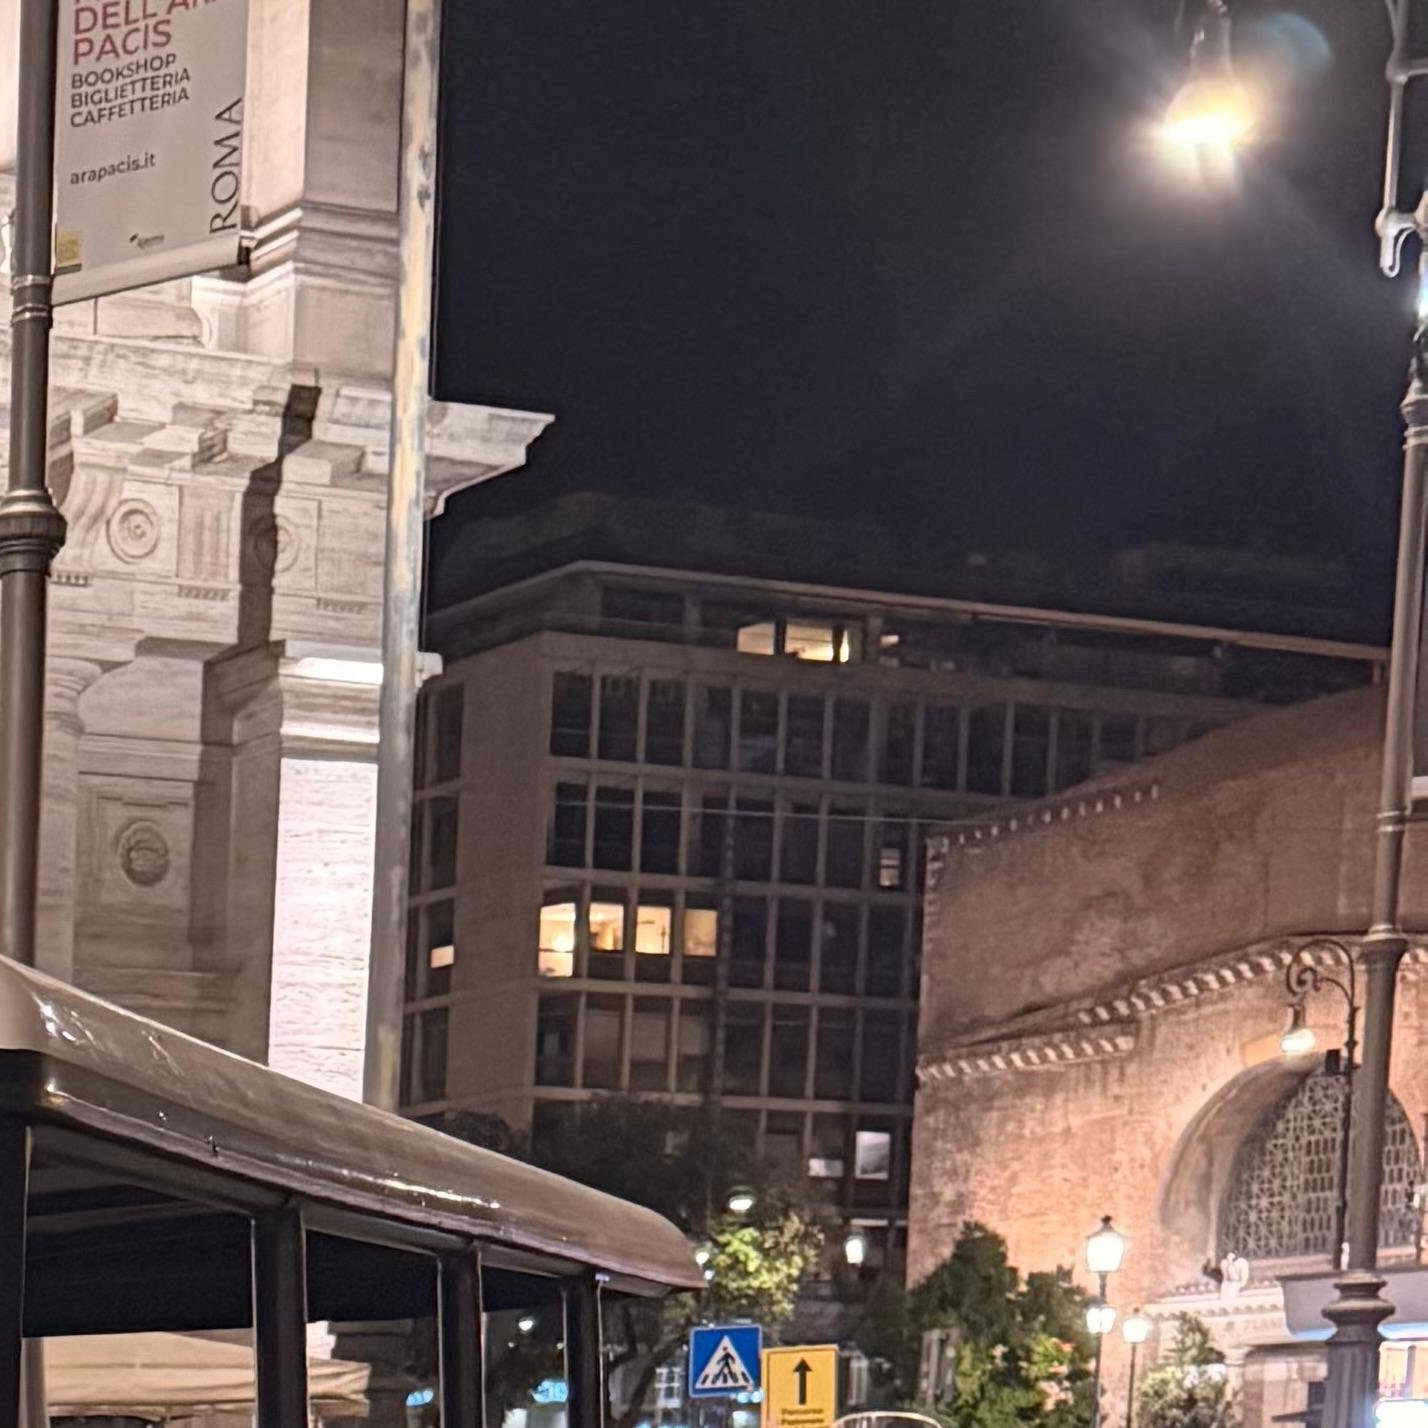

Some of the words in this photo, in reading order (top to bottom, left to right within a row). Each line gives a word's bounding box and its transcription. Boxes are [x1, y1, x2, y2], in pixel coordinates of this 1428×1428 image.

[73, 19, 172, 65] PACIS
[71, 53, 177, 89] BOOKSHOP
[71, 68, 191, 109] BIGLIETTERIA
[70, 87, 190, 127] CAFFETTERIA
[70, 152, 156, 184] arapacis.it
[209, 96, 243, 235] ROMA
